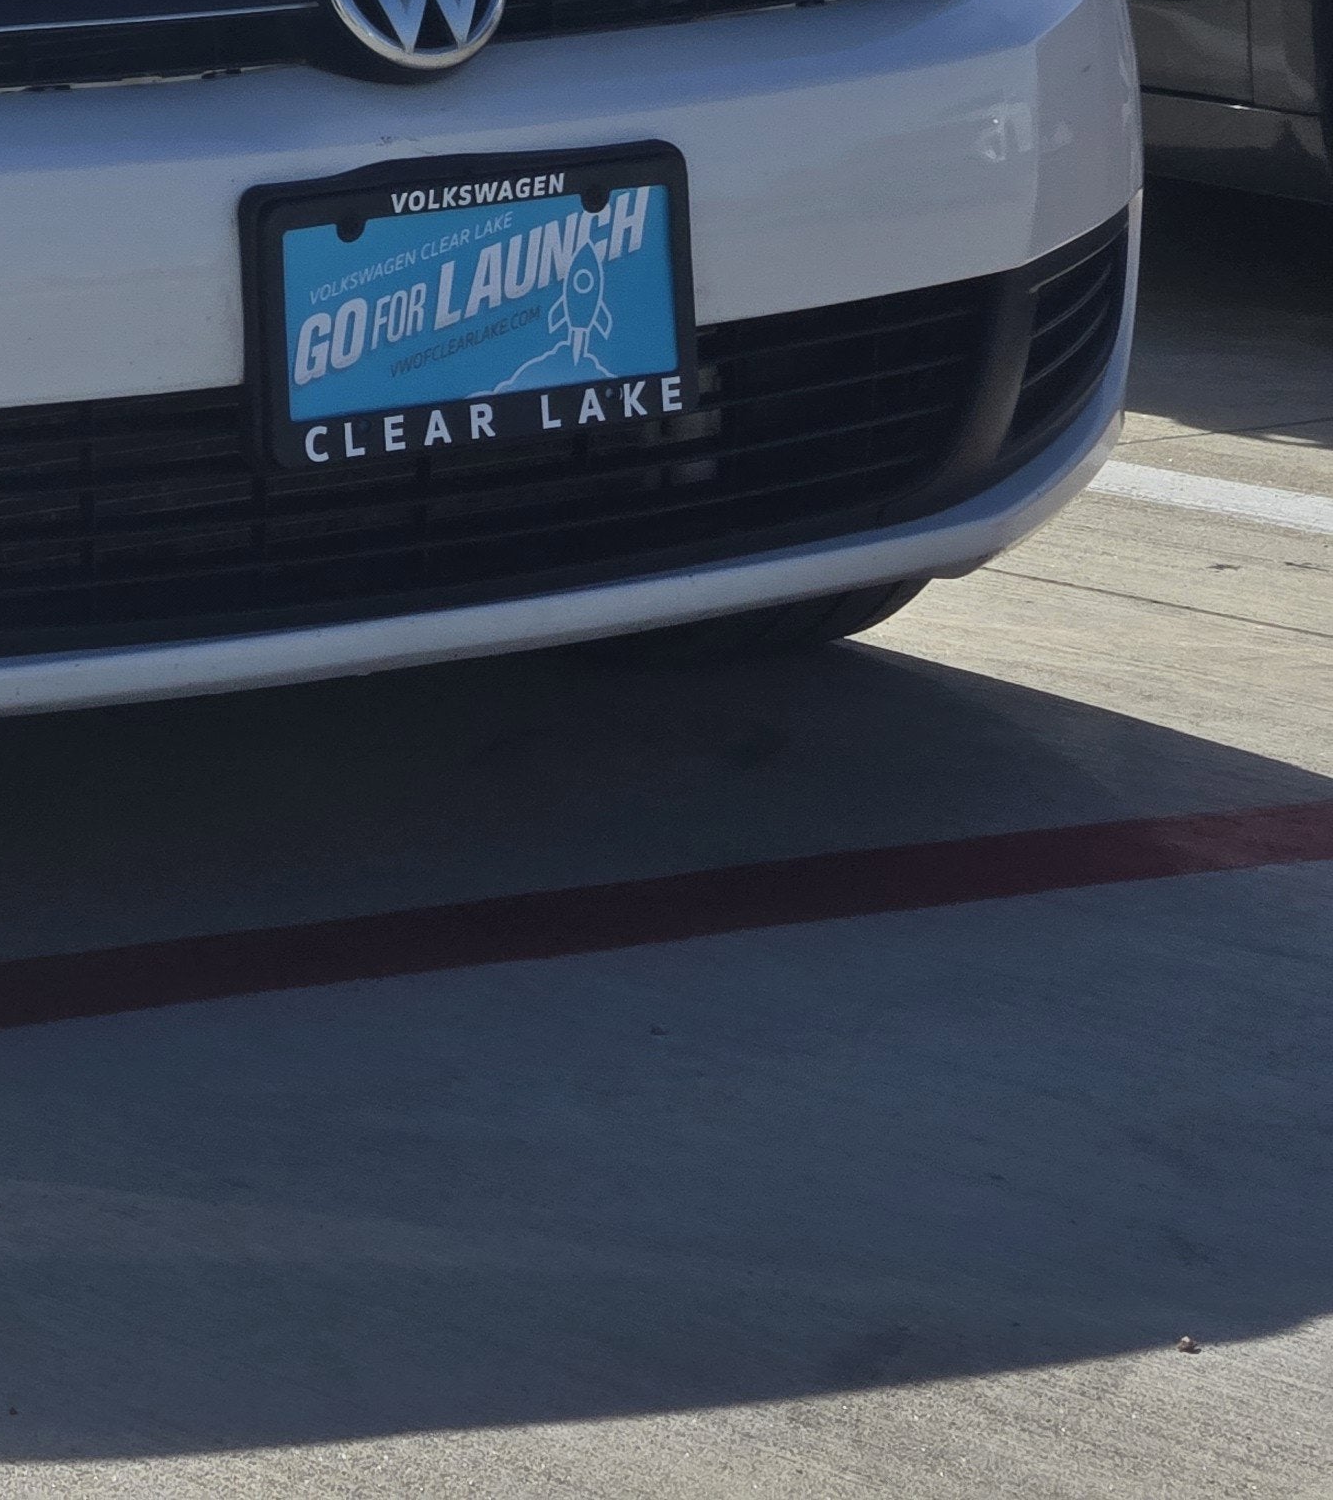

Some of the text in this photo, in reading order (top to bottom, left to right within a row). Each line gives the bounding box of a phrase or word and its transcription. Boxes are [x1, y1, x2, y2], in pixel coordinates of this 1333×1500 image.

[390, 173, 565, 214] VOLKSWAGEN
[293, 186, 651, 386] GO FOR LAUNCH
[310, 211, 514, 305] VOLKSWAGEN CLEAR LAKE
[304, 376, 684, 463] CLEAR LAKE
